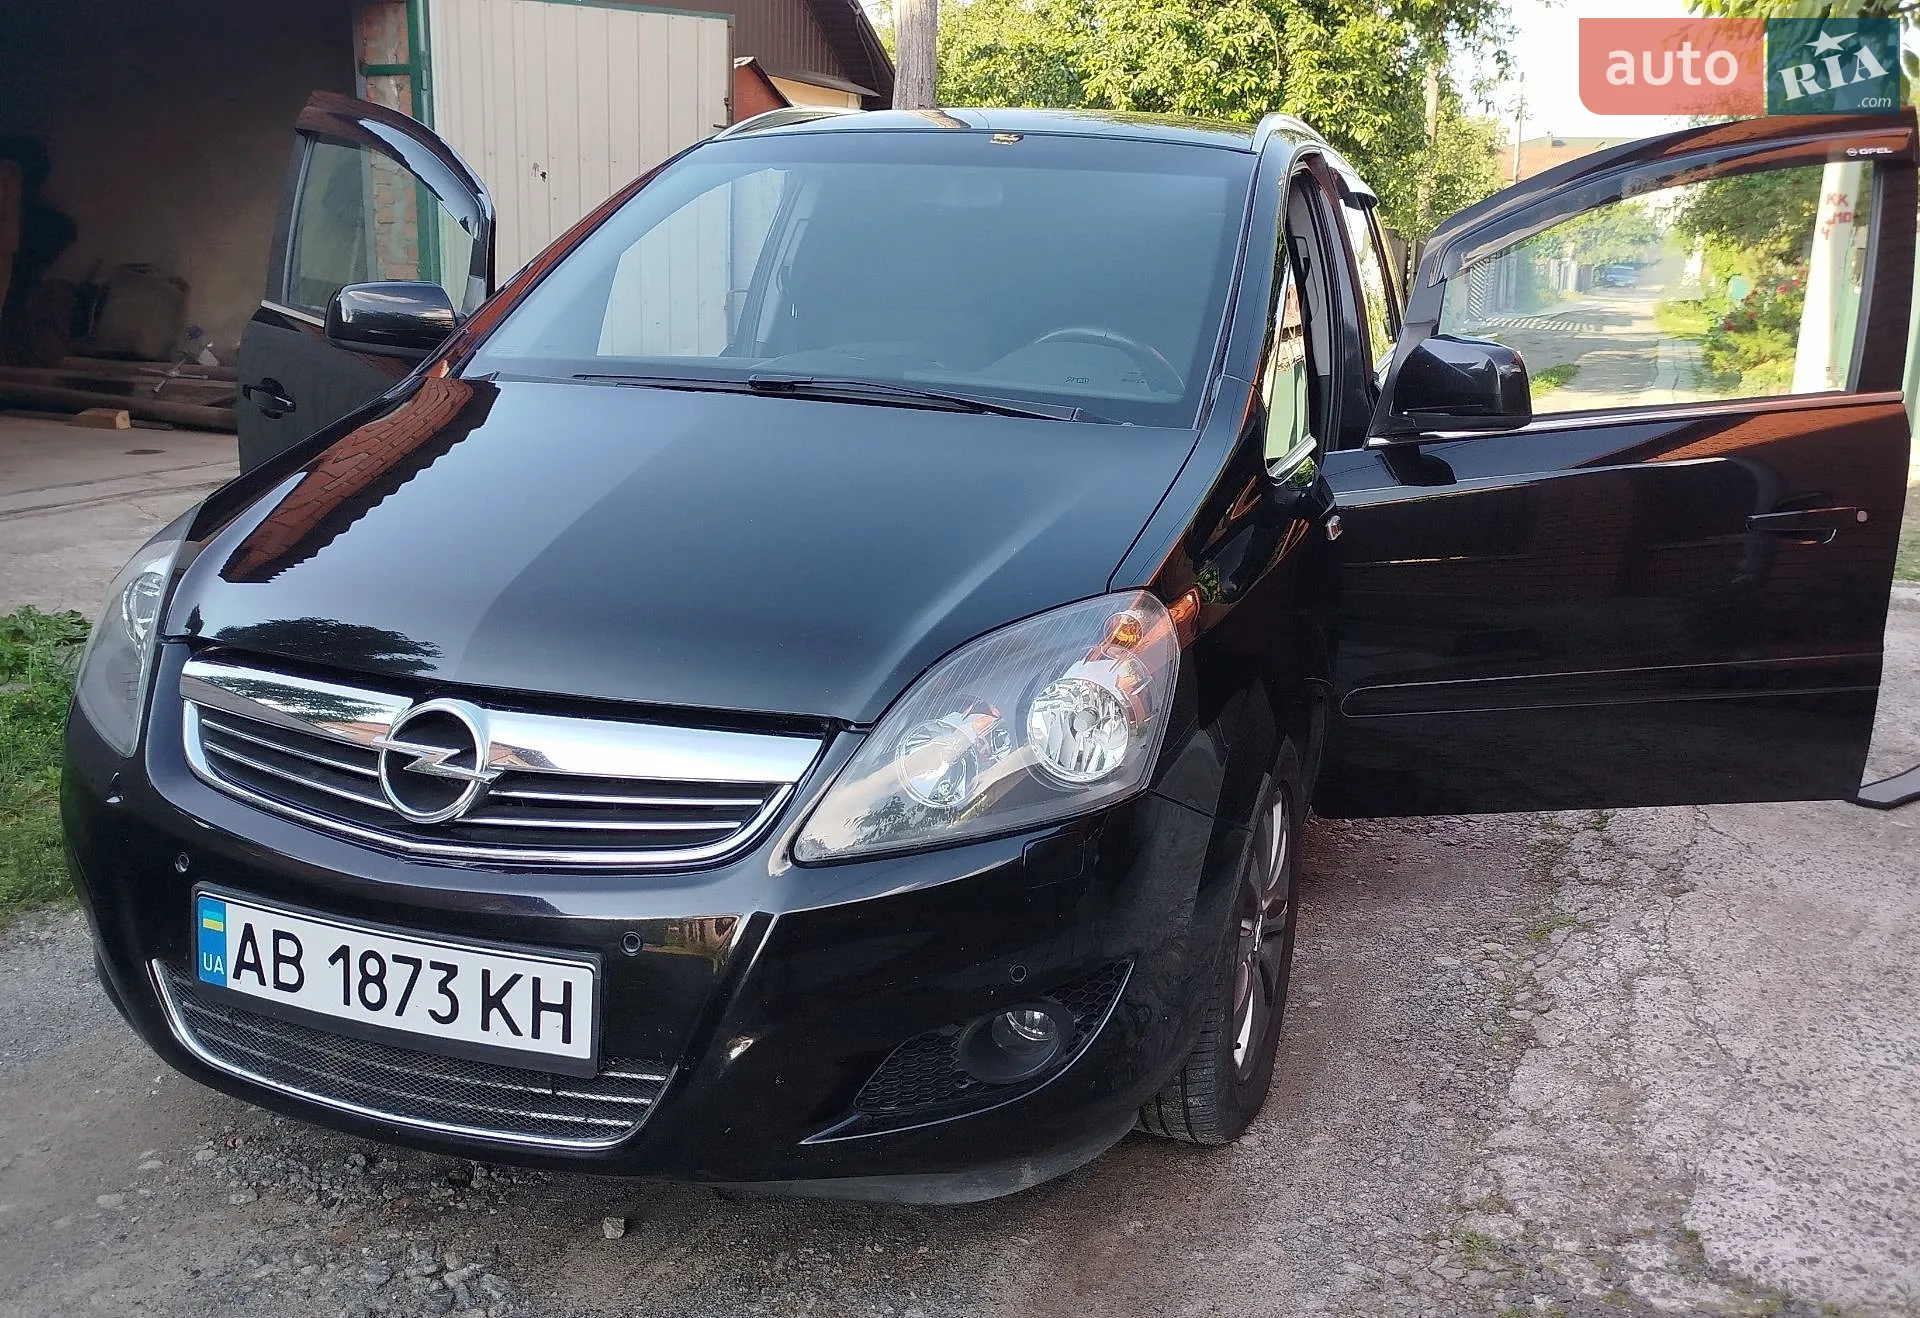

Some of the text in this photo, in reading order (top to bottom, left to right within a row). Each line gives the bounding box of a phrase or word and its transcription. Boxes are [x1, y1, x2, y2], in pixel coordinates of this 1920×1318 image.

[203, 952, 224, 975] UA
[233, 923, 573, 1045] AB 1873 KH
